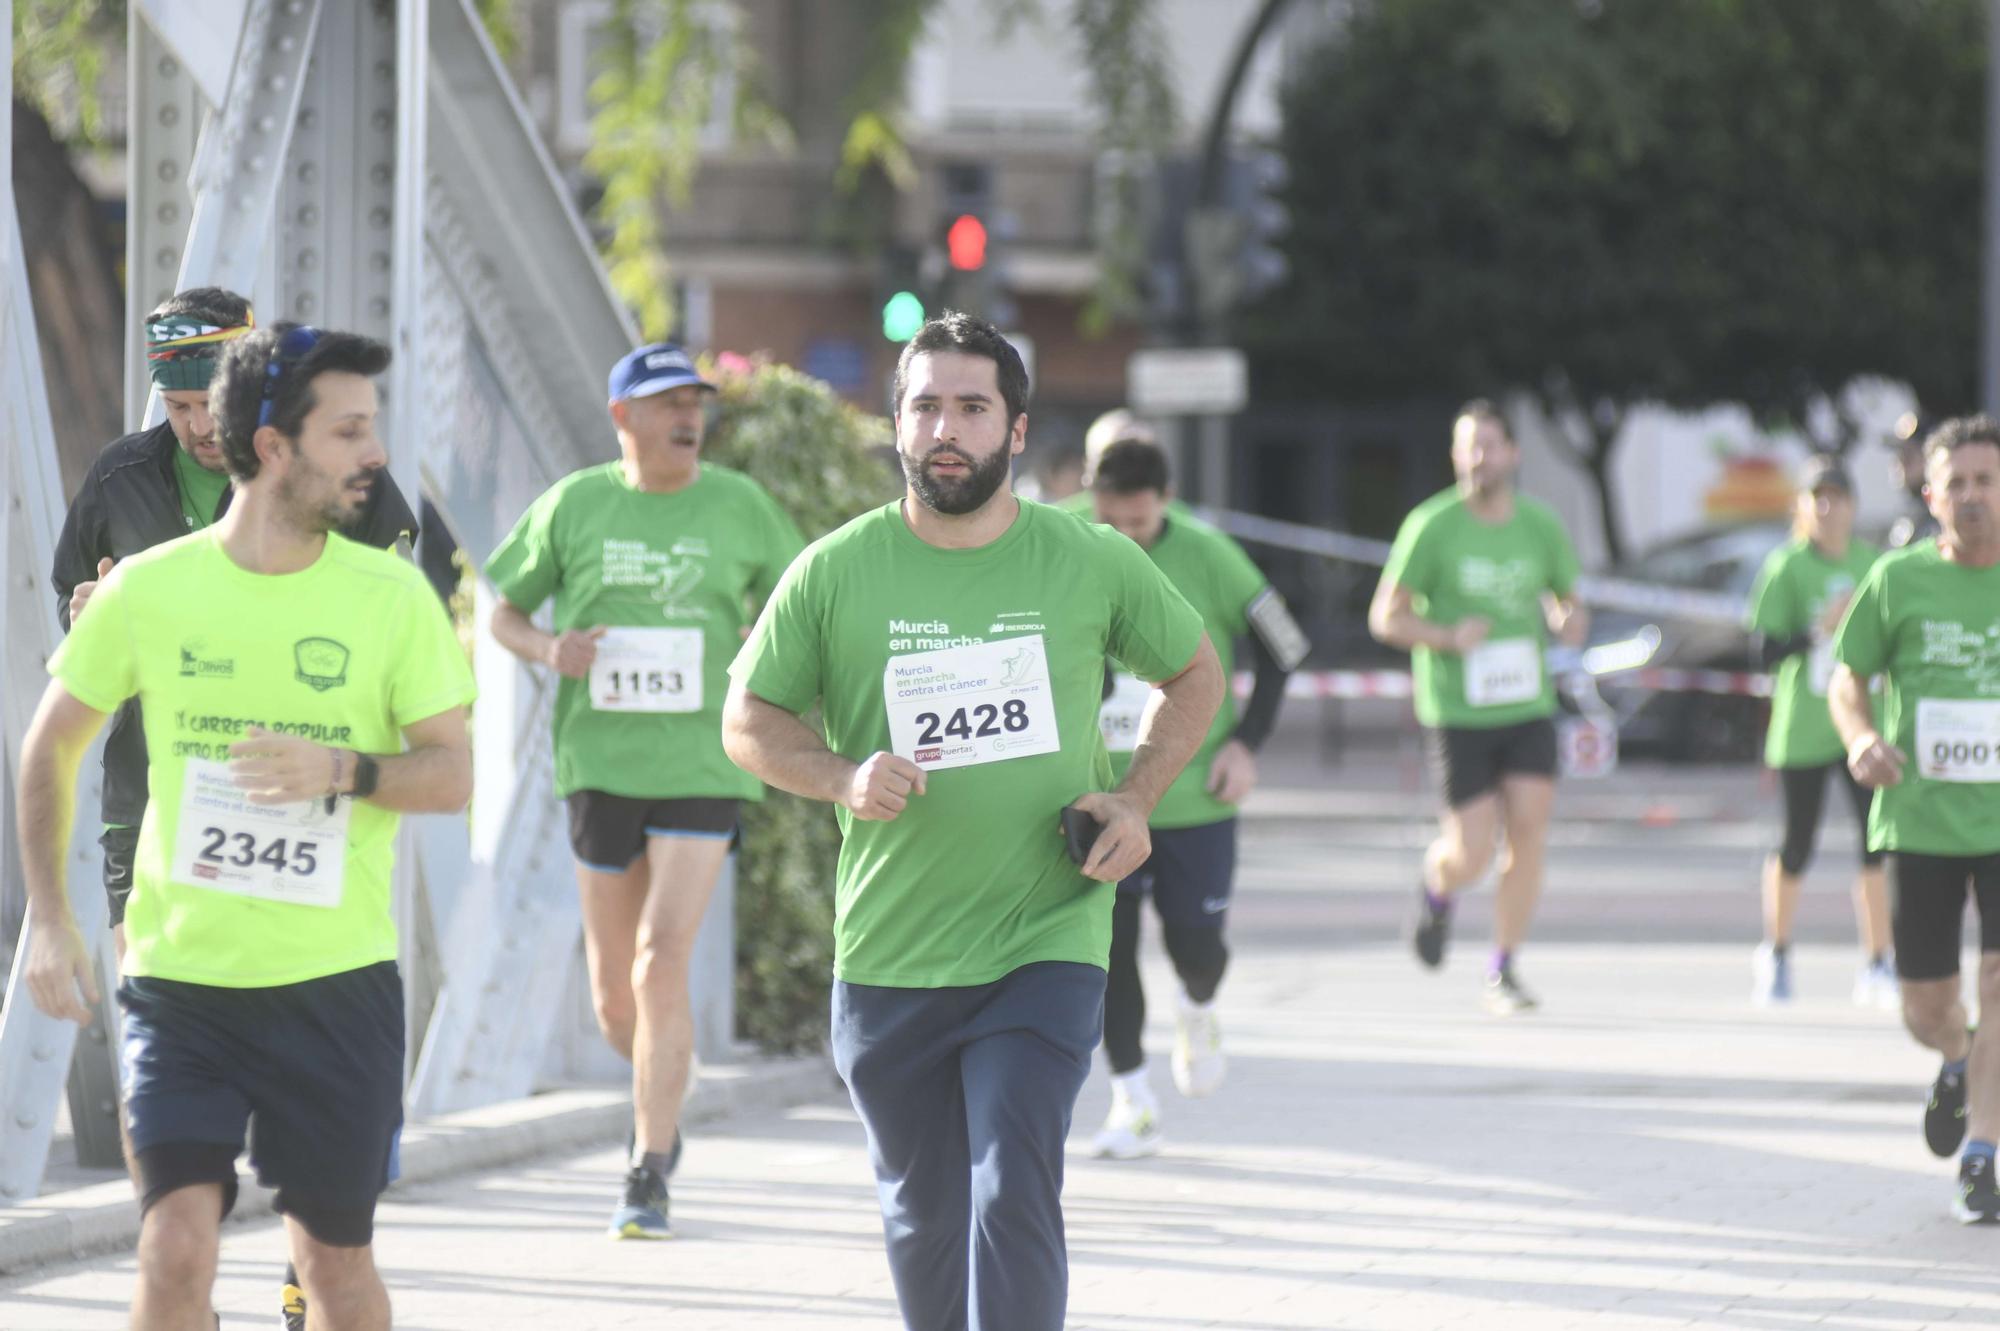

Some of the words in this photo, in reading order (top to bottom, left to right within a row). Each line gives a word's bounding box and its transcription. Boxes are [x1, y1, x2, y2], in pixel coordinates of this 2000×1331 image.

[889, 620, 950, 634] Murcia
[1005, 623, 1046, 632] IBERDROLA
[889, 638, 912, 651] en
[917, 635, 984, 650] marcha
[895, 664, 933, 678] Murcia
[897, 679, 912, 688] en
[914, 672, 956, 686] marcha
[608, 670, 684, 694] 1153
[898, 684, 935, 699] contra
[937, 682, 948, 693] el
[949, 677, 989, 692] cáncer
[271, 721, 352, 742] POPULAR
[915, 698, 1030, 745] 2428
[171, 741, 210, 760] CENTRO
[193, 795, 230, 809] contra
[232, 802, 243, 812] el
[245, 803, 287, 818] cáncer
[199, 826, 318, 876] 2345
